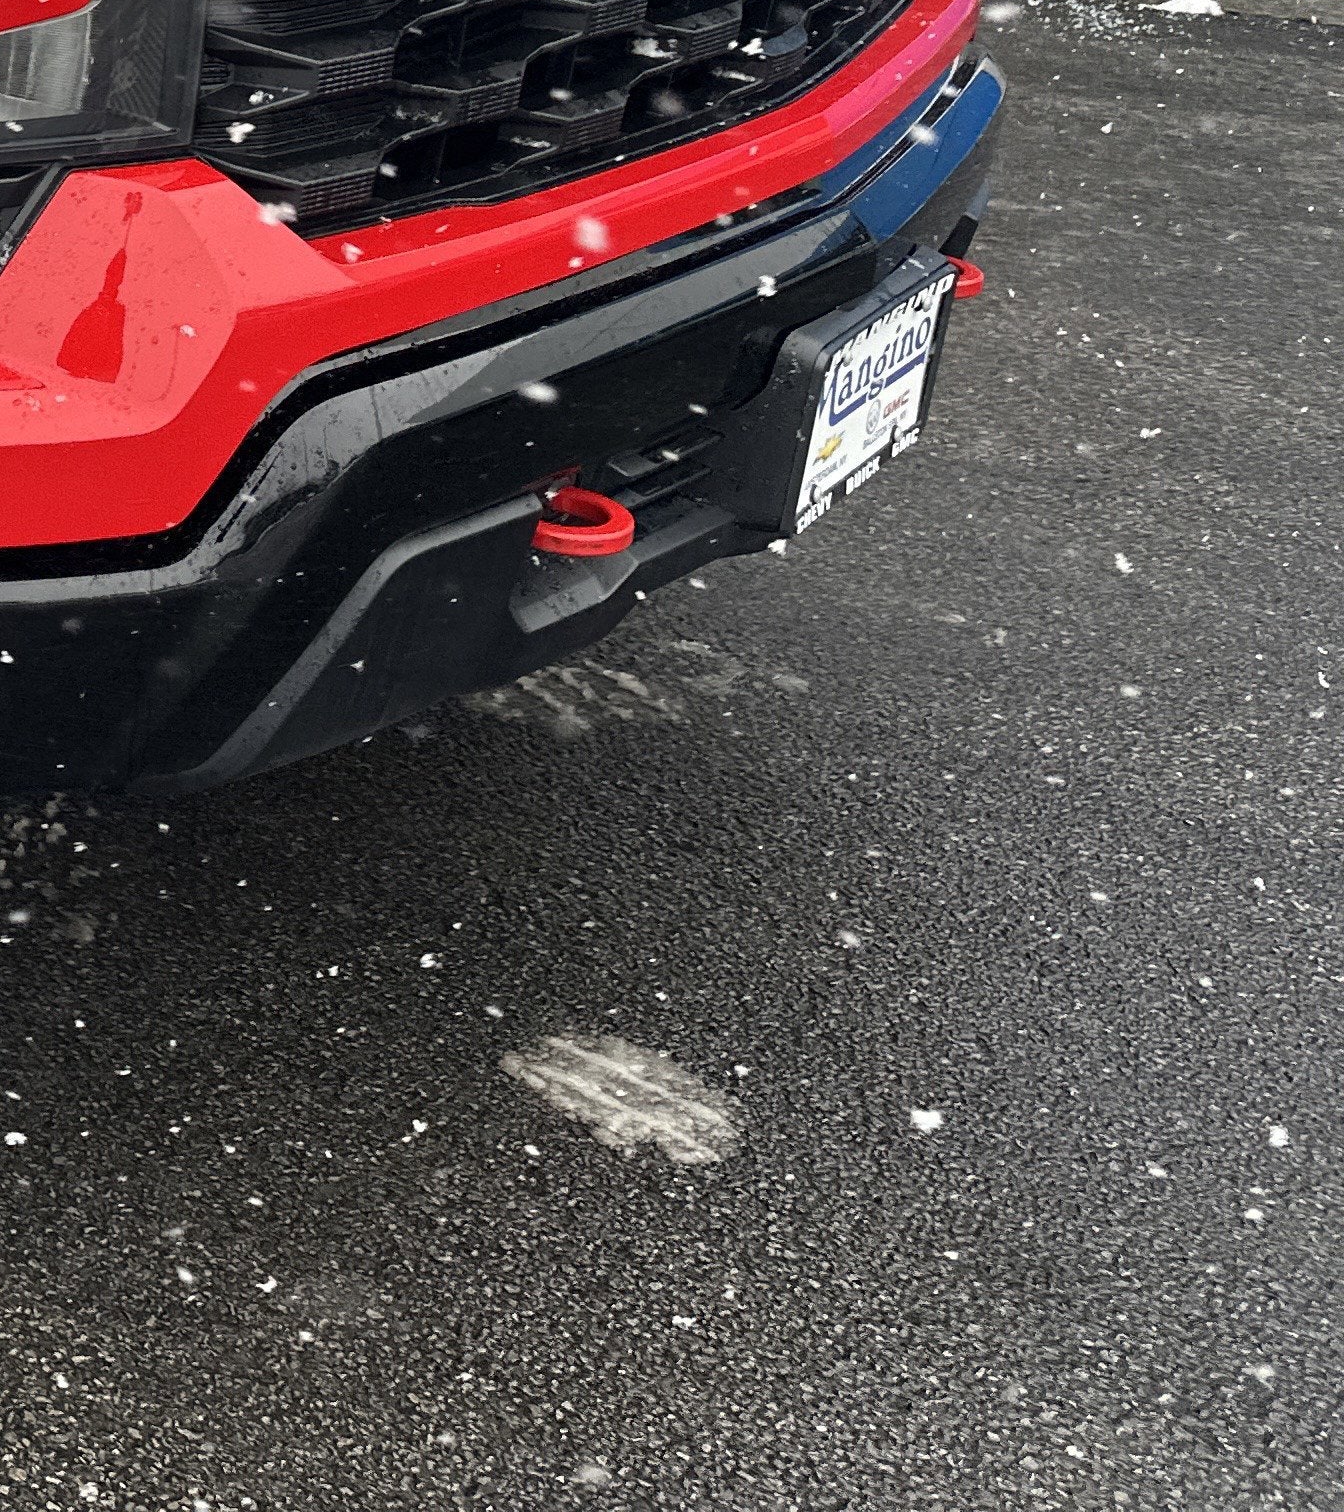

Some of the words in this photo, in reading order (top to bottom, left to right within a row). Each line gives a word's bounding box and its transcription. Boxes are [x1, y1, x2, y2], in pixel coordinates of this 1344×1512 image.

[817, 316, 932, 426] Mangino
[795, 492, 833, 535] CHEVY
[845, 455, 881, 496] BUICK
[890, 427, 920, 458] GMC
